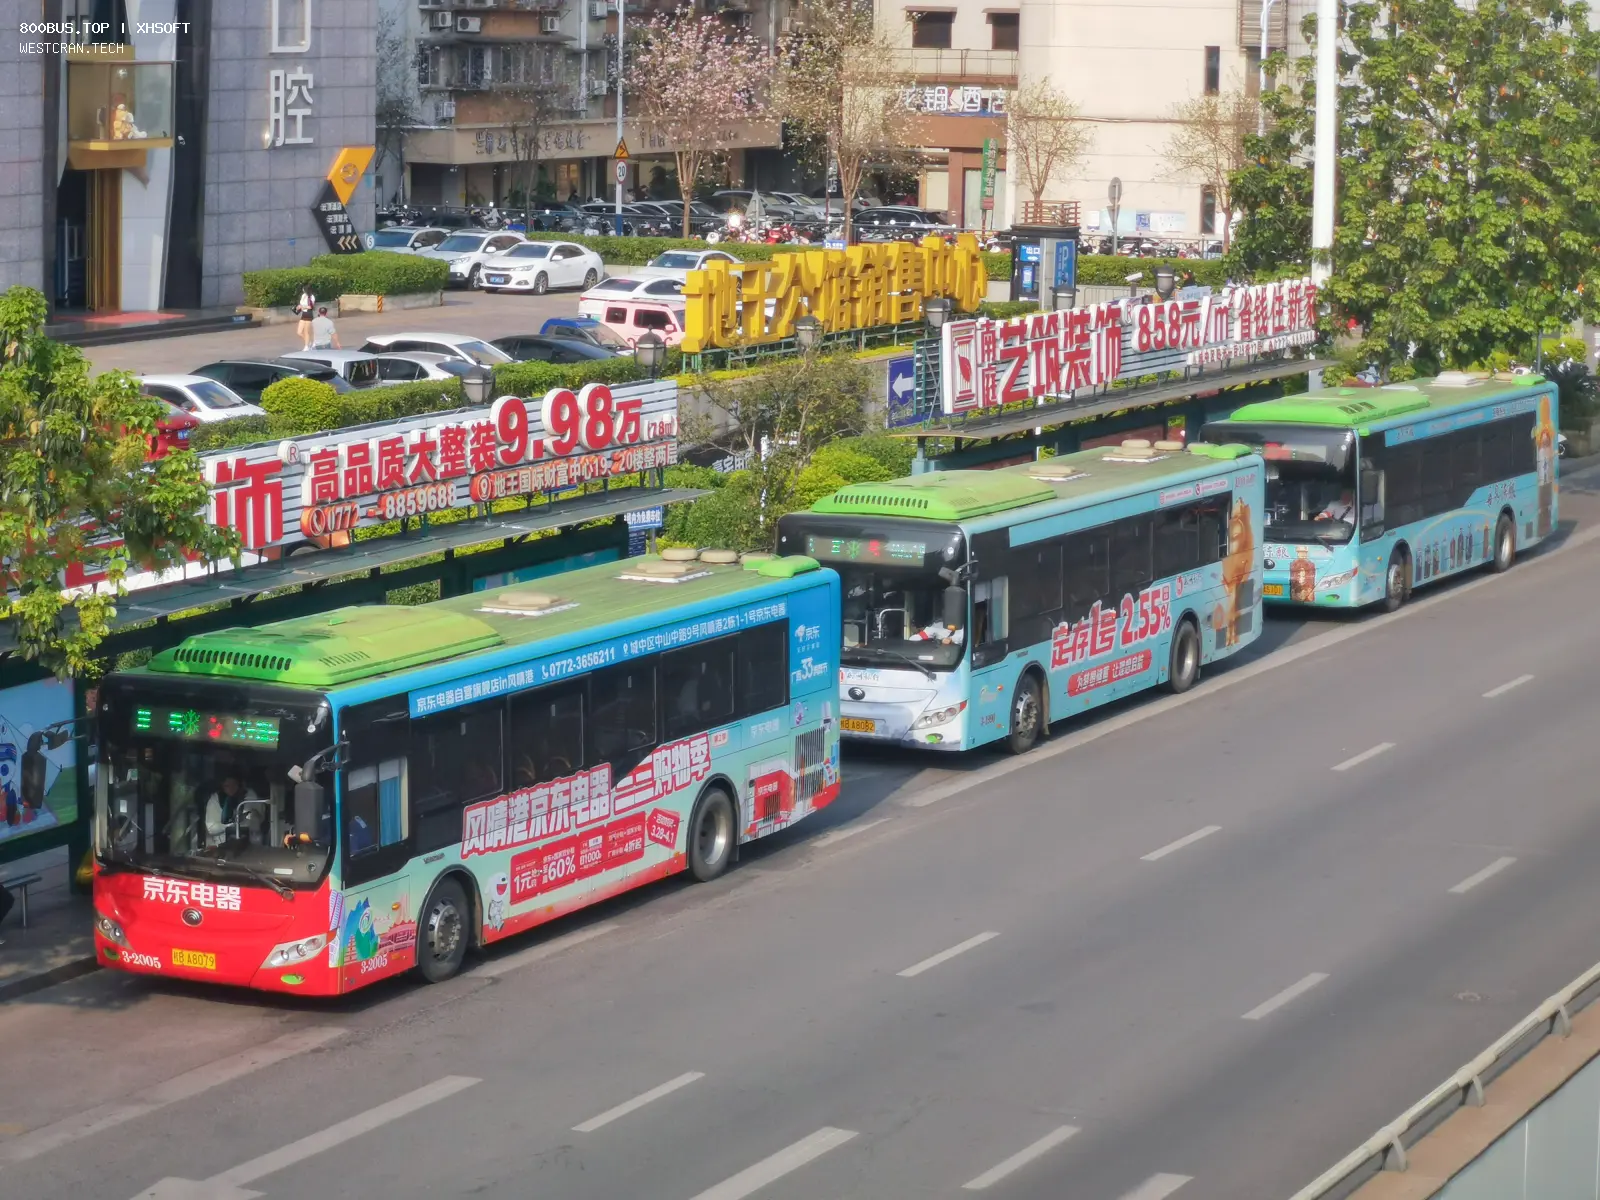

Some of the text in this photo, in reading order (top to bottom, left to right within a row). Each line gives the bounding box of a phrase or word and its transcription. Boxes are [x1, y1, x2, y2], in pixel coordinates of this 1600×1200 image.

[617, 165, 626, 178] 20
[1121, 586, 1171, 646] 2.55%
[549, 647, 615, 678] 0772-3656211
[548, 855, 576, 880] 60%
[143, 876, 241, 911] 京东电器
[122, 950, 161, 969] 3-2005
[361, 953, 388, 974] 3-2005
